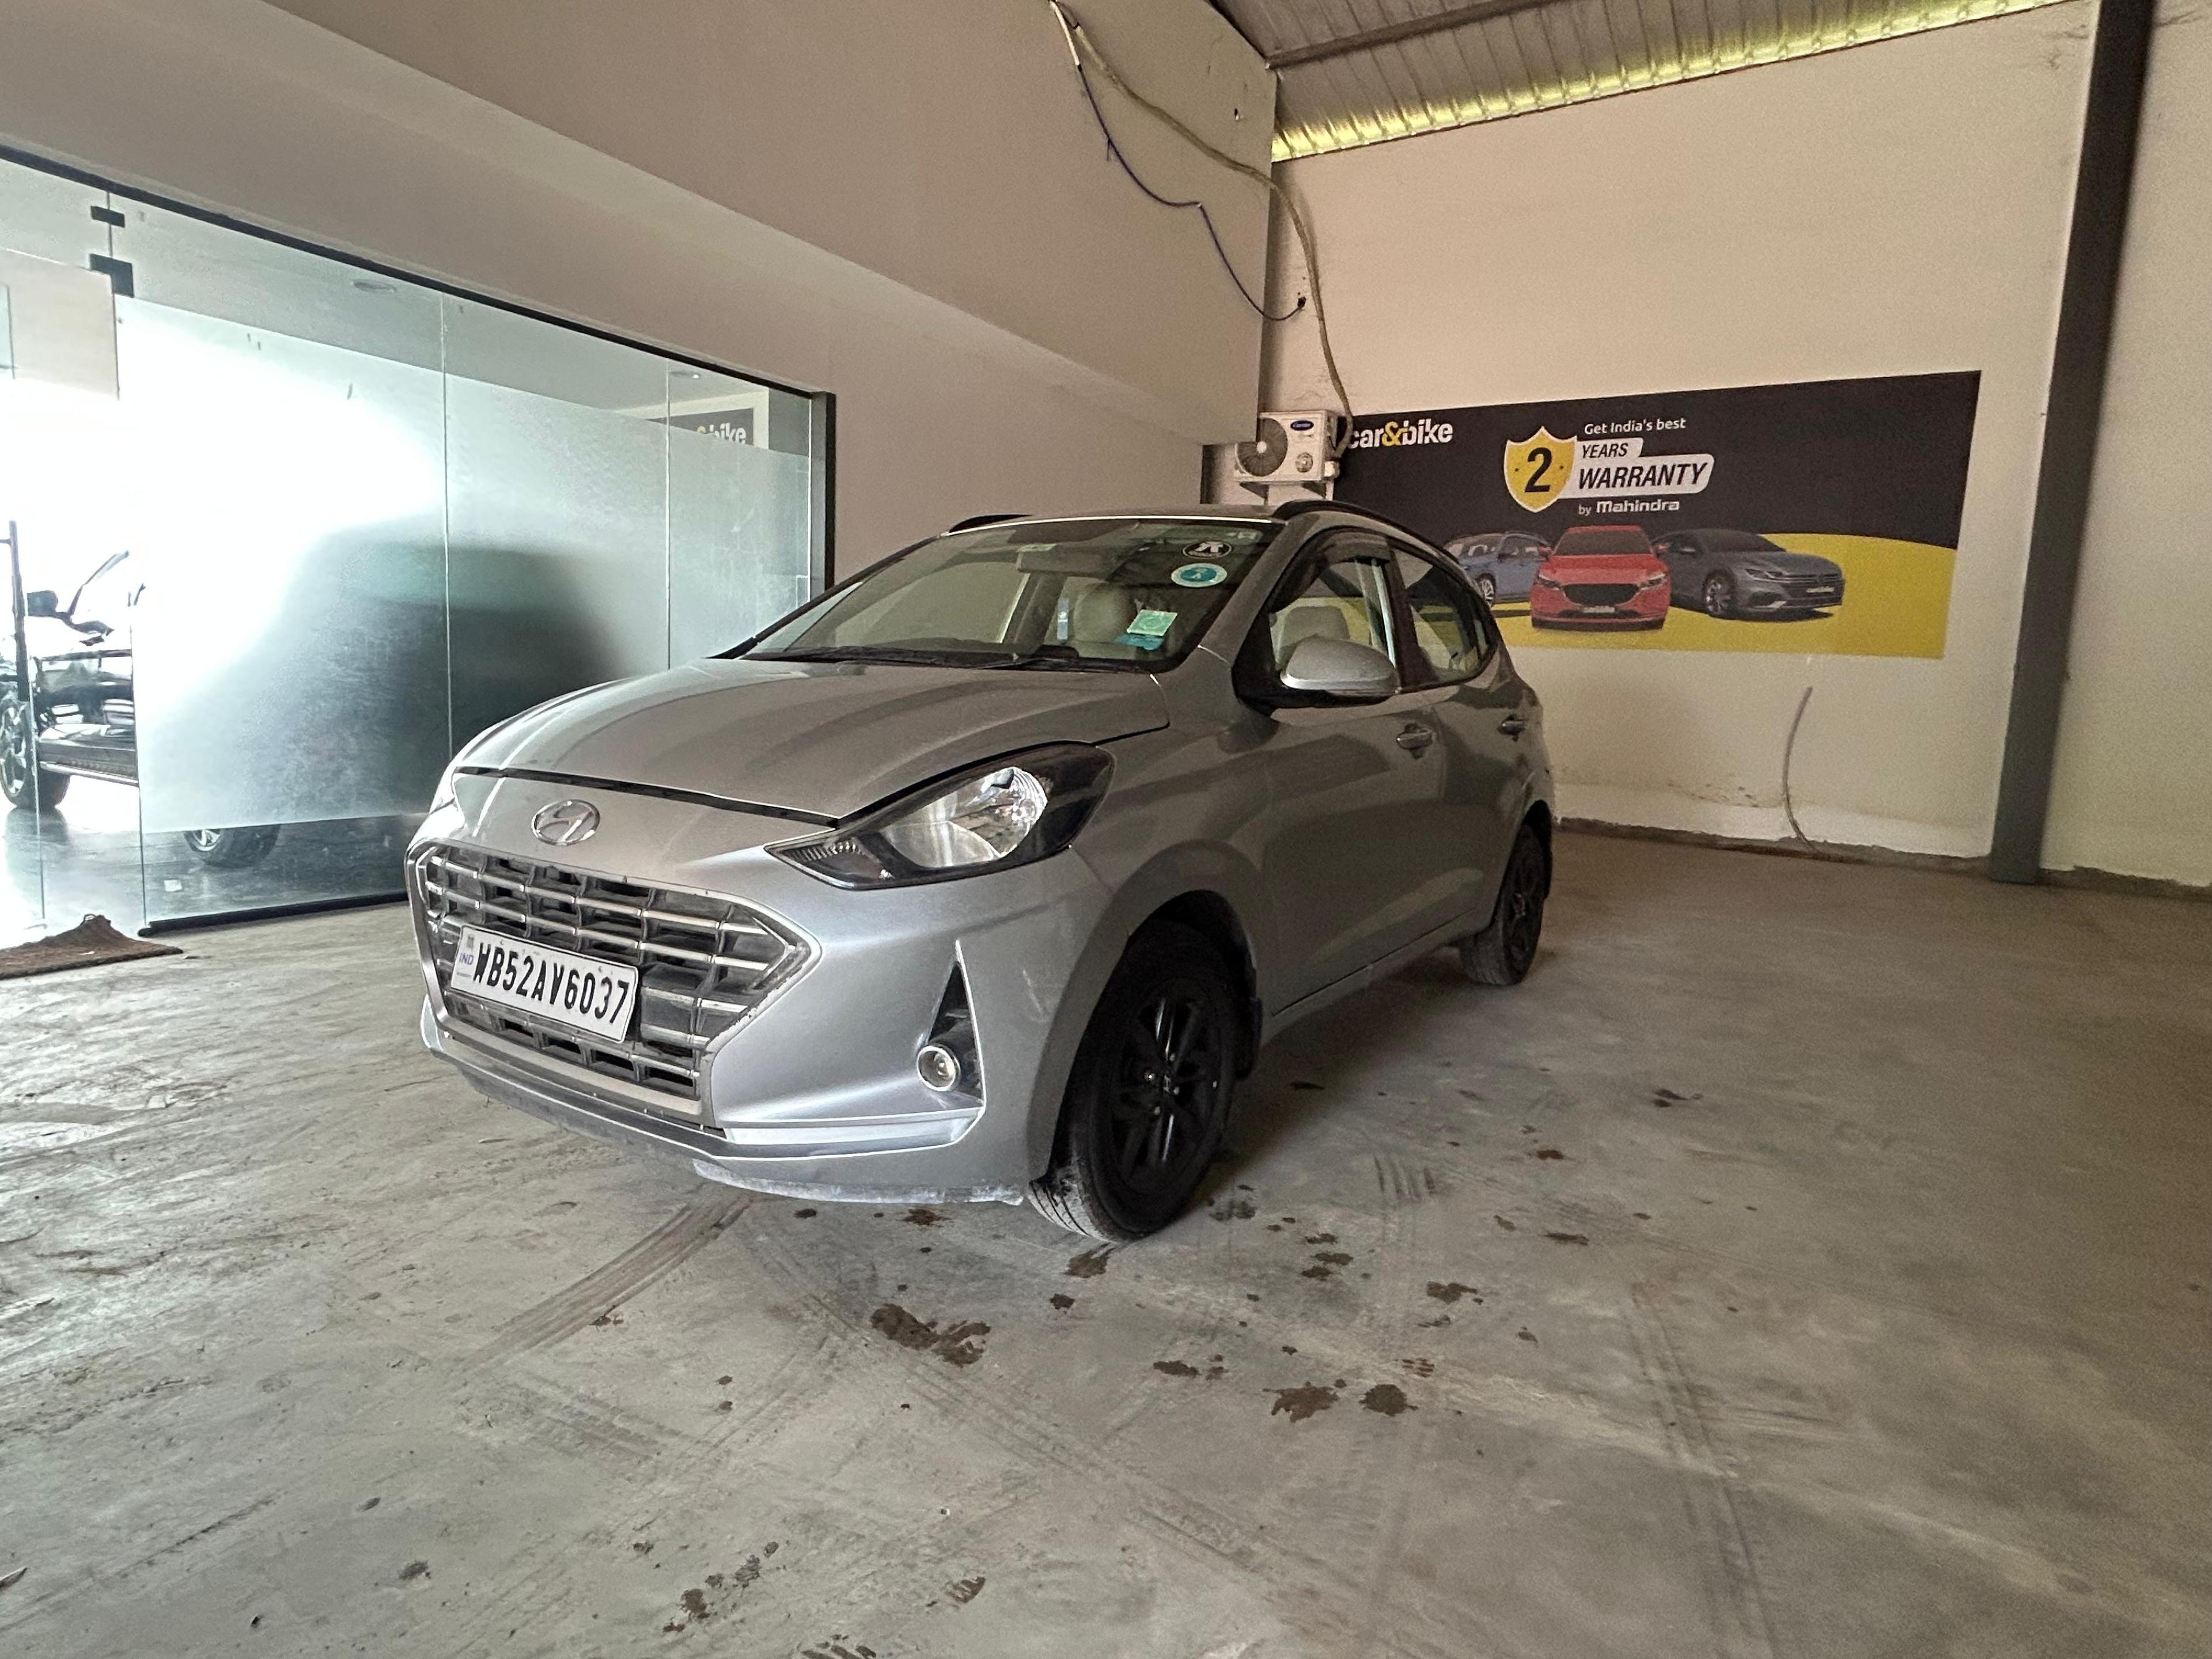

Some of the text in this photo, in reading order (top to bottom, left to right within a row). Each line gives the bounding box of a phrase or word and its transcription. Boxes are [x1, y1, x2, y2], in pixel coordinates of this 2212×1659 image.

[1347, 418, 1453, 449] car&bike
[1584, 418, 1687, 434] Get India's best
[1582, 442, 1629, 459] YEARS
[1524, 447, 1552, 493] 2
[1578, 463, 1708, 490] WARRANTY
[1578, 499, 1680, 516] by Mahindra
[459, 952, 474, 965] IND
